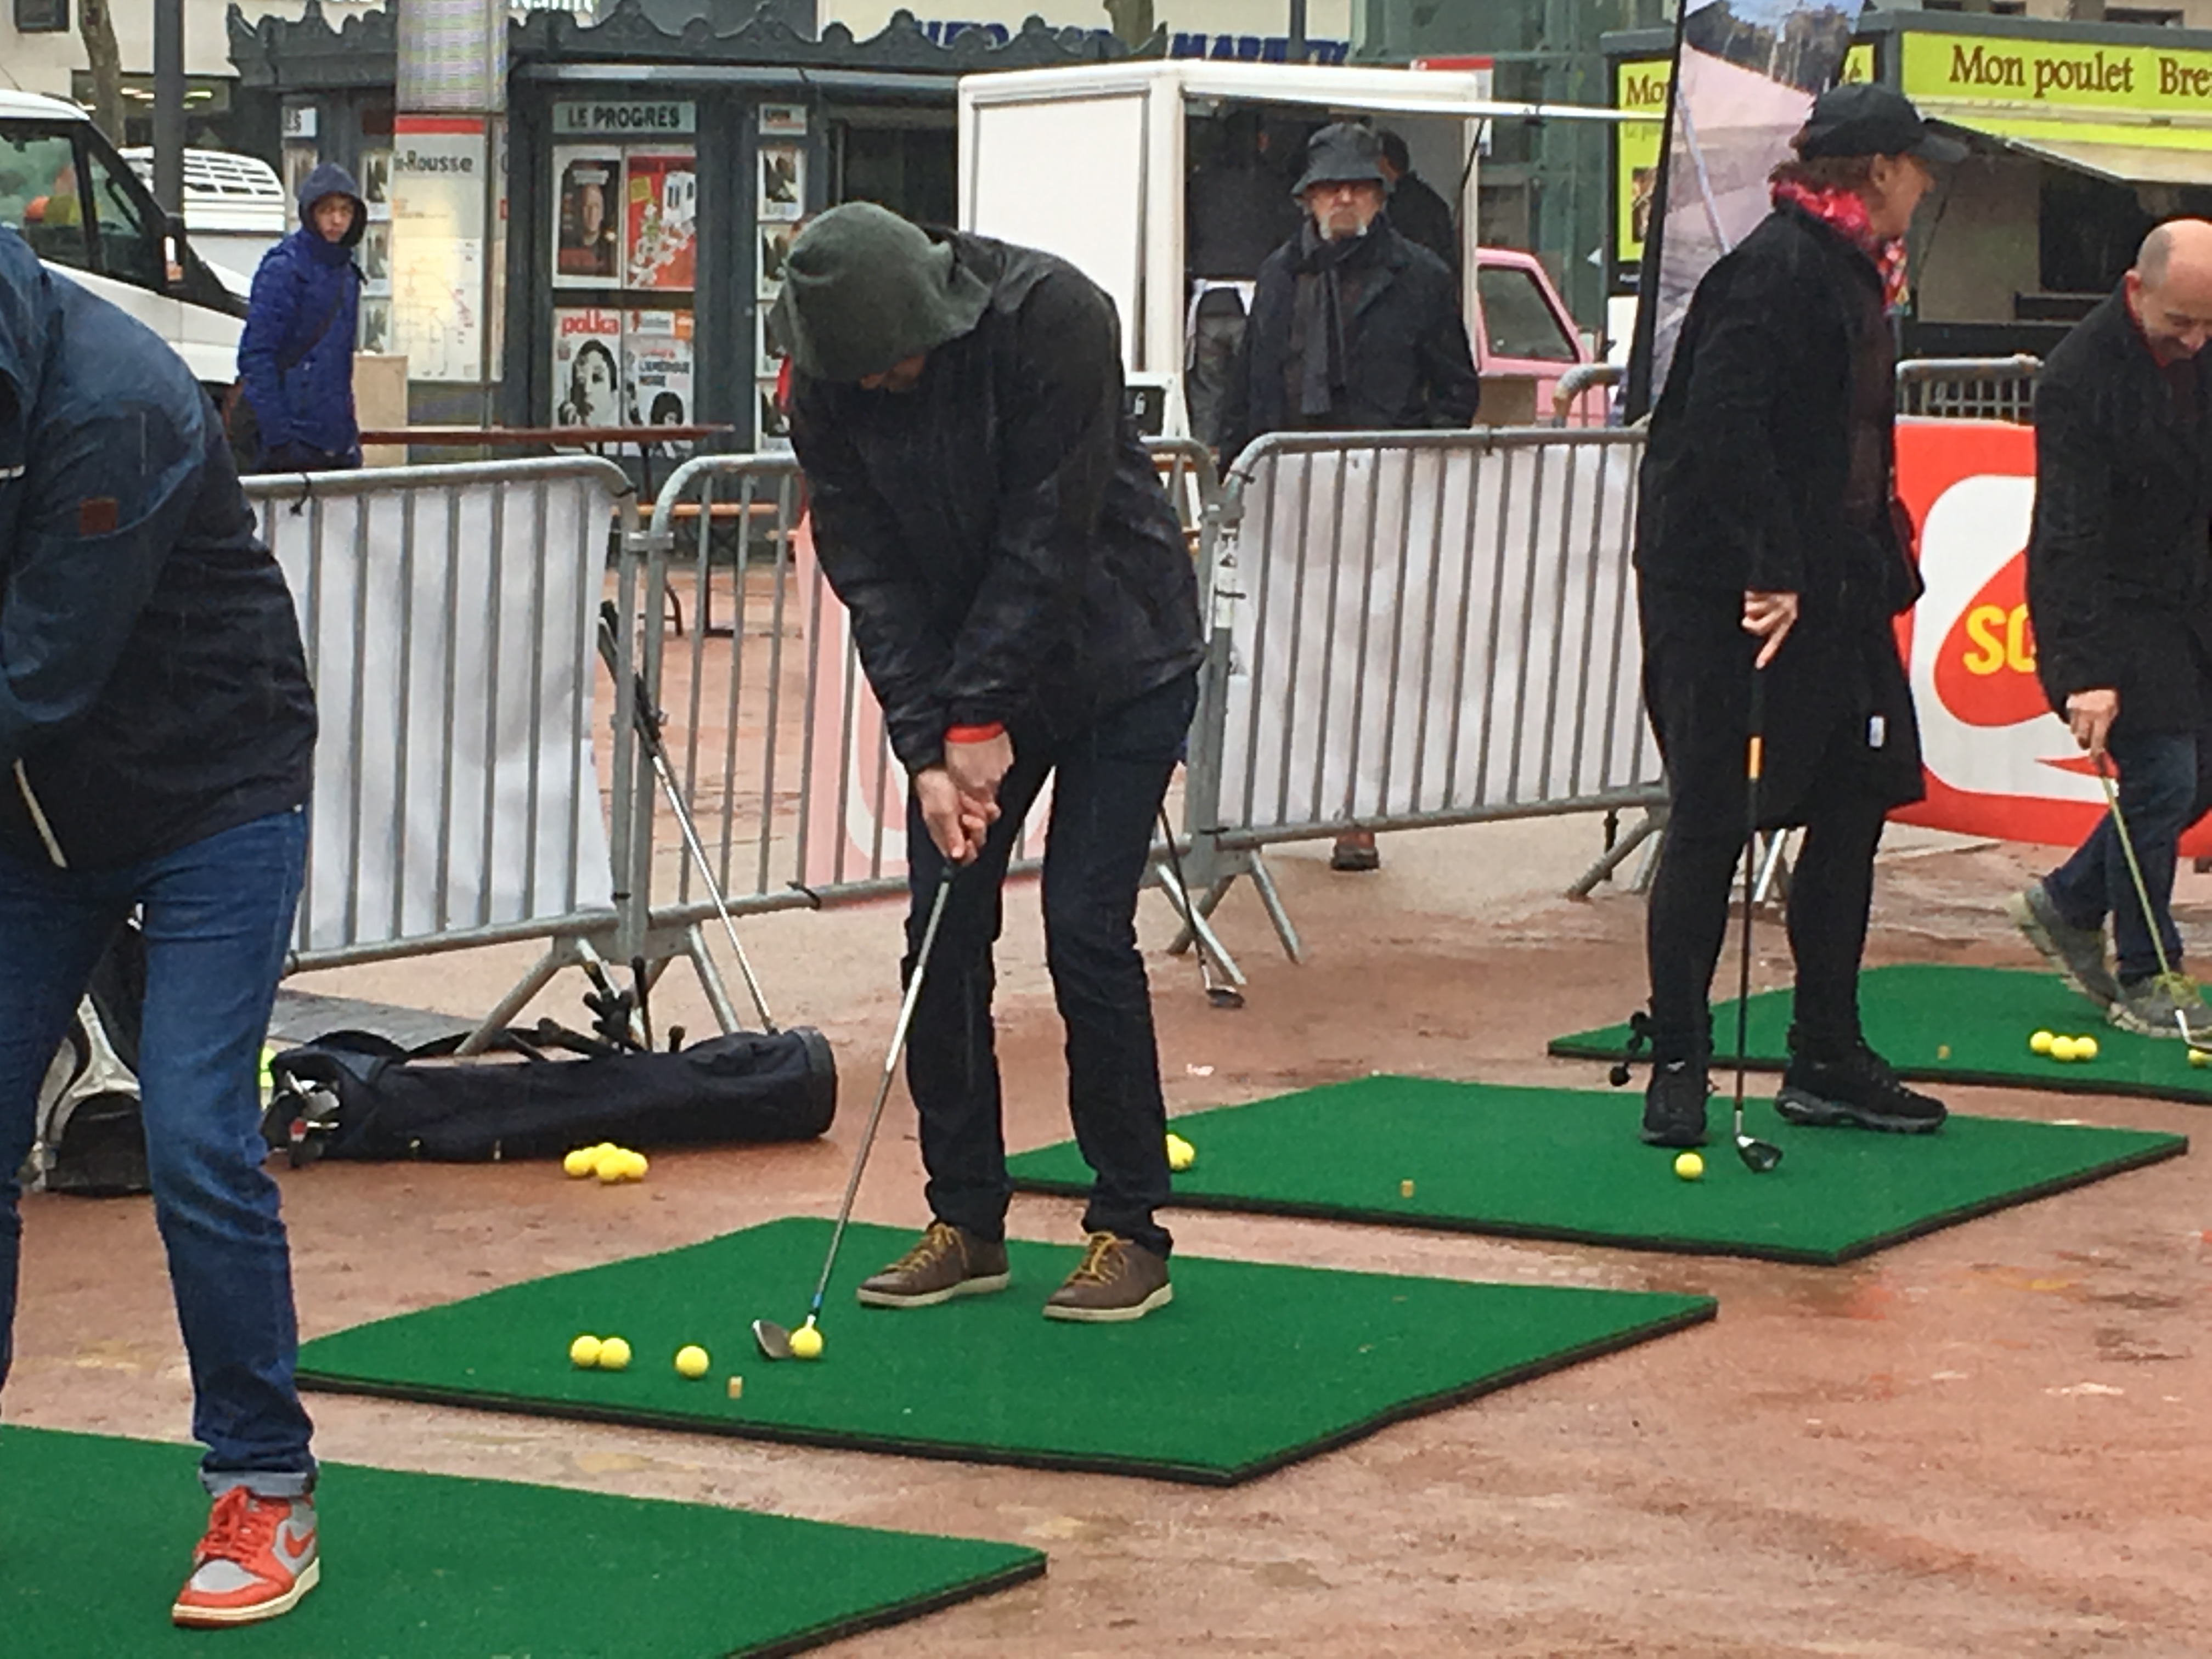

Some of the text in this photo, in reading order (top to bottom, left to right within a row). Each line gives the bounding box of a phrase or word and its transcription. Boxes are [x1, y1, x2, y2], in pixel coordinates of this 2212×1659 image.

[1950, 44, 2212, 98] Mon poulet Bre
[1626, 74, 1669, 106] Mo
[568, 107, 588, 127] LE
[561, 308, 619, 337] polka
